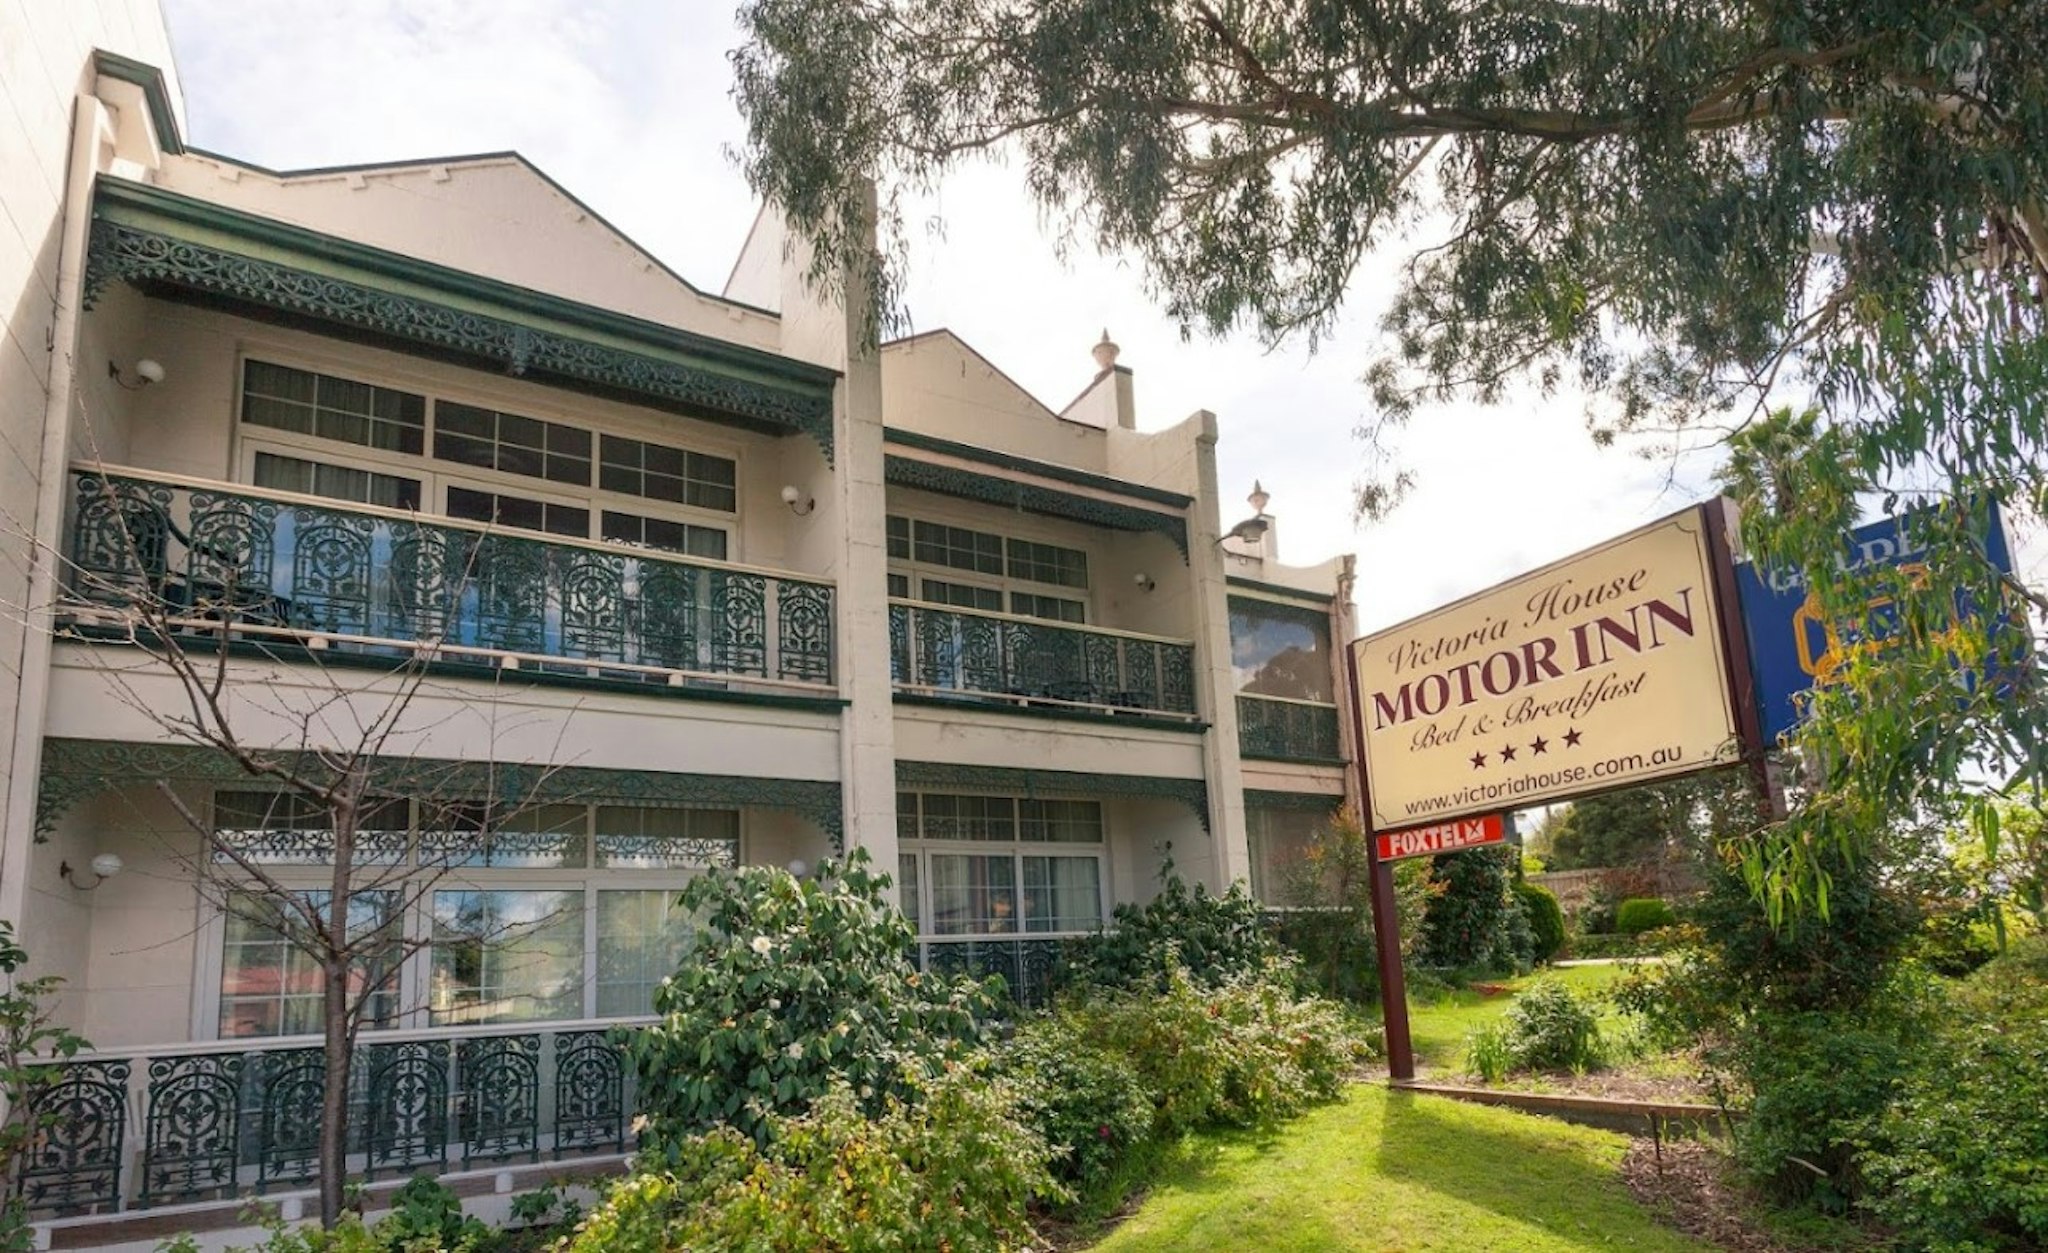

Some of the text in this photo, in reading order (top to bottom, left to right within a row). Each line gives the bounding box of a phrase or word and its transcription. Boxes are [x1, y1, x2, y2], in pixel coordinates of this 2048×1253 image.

[1370, 636, 1565, 731] MOTOR
[1569, 586, 1695, 672] INN
[1388, 568, 1648, 675] Victoria House
[1410, 671, 1648, 752] Bed & Breakfast
[1405, 745, 1683, 815] www.victoriahouse.com.au
[1389, 821, 1465, 856] FOXTEL
